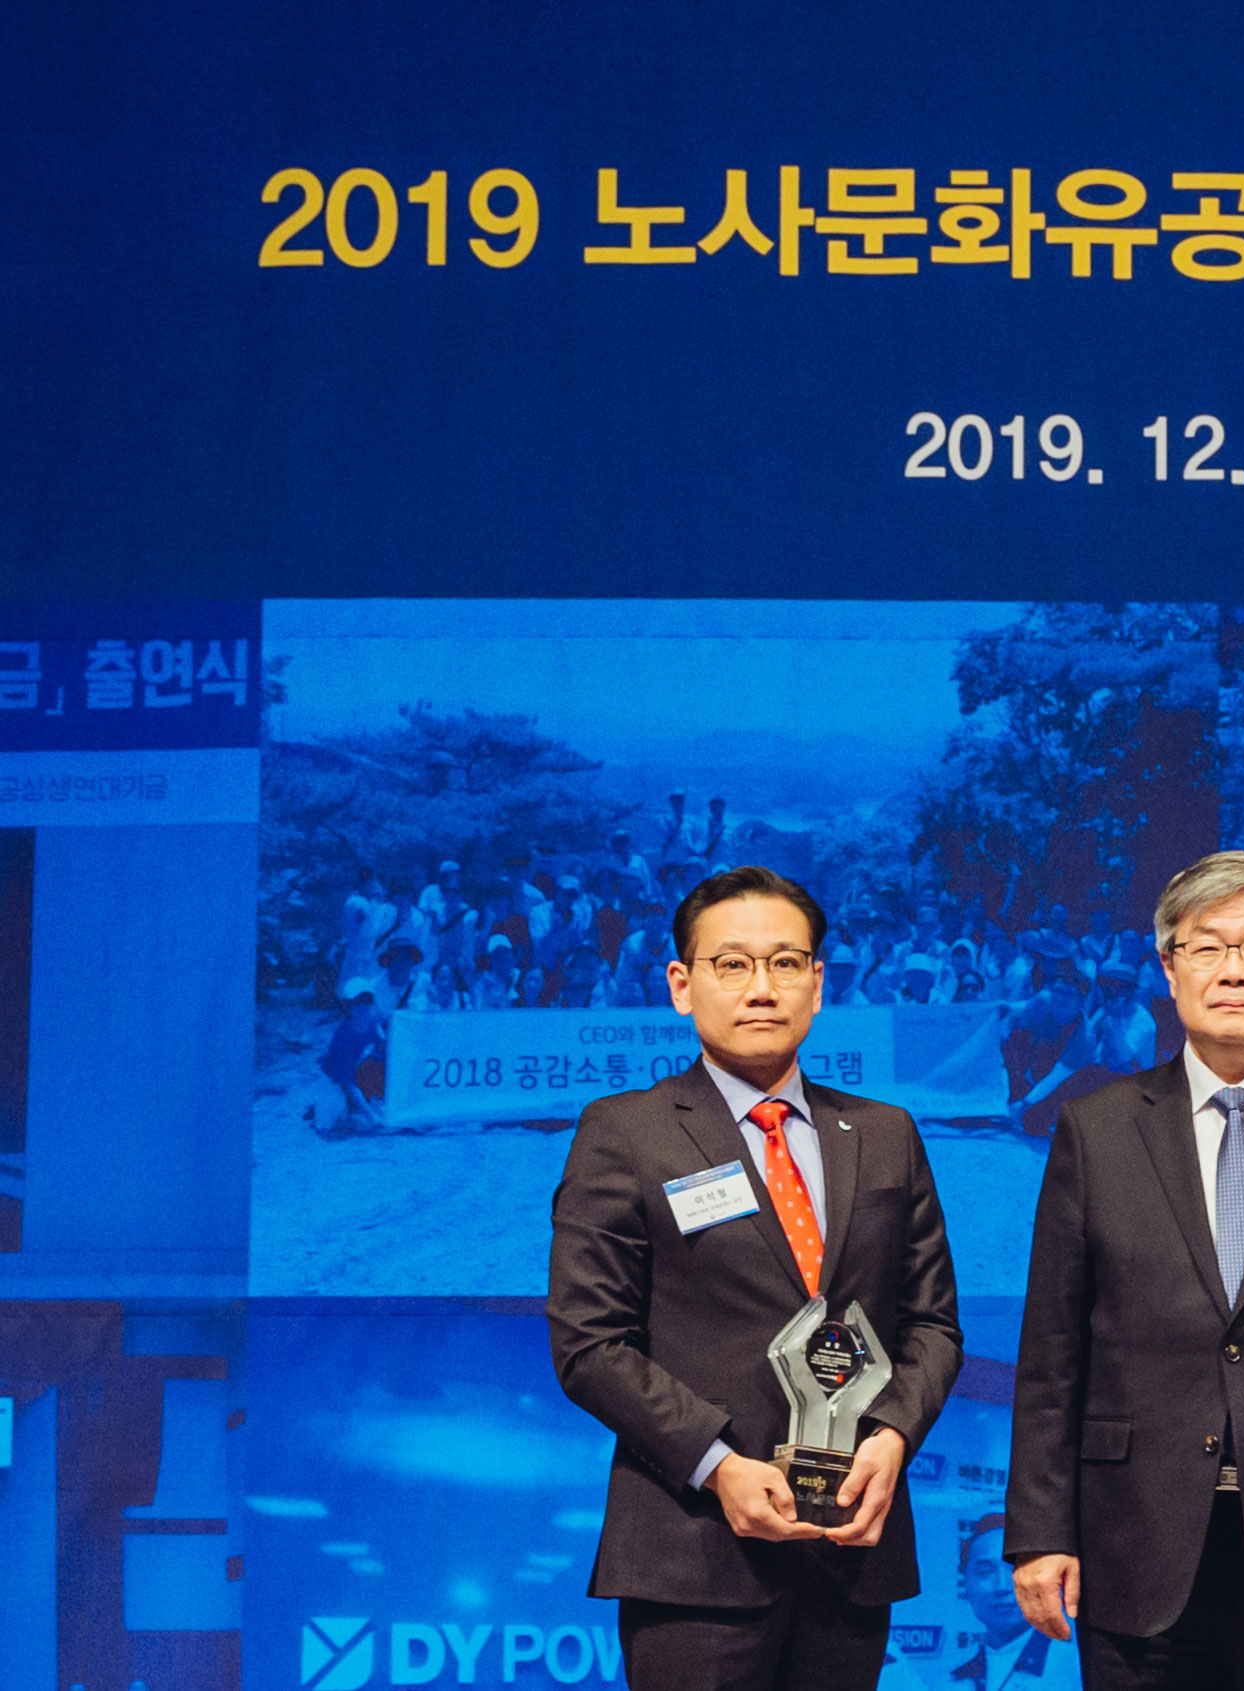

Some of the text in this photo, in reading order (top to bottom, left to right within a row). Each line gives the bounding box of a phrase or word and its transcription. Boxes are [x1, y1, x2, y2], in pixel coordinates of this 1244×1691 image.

[258, 167, 540, 268] 2019
[904, 411, 1103, 485] 2019.
[84, 638, 249, 710] 출연식
[579, 1025, 700, 1046] CEO와 함께하
[424, 1057, 503, 1088] 2018
[797, 1050, 863, 1085] 그램
[391, 1623, 493, 1684] DY
